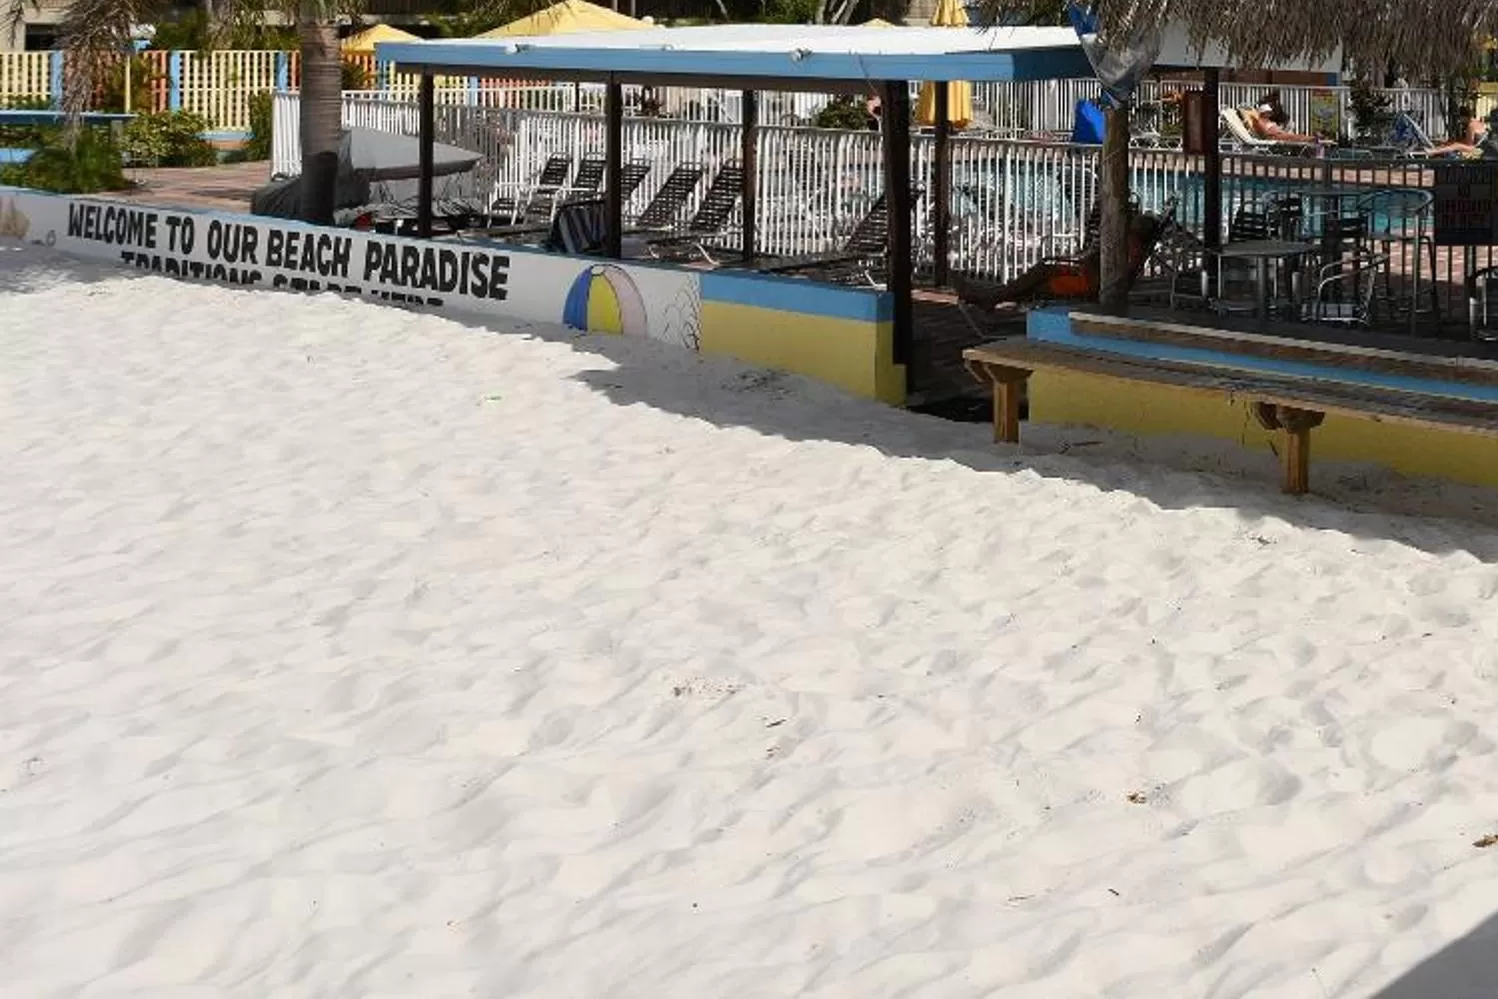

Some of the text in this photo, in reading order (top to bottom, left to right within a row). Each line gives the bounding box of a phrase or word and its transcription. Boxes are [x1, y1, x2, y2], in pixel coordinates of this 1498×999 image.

[67, 203, 158, 248] WELCOME
[165, 215, 194, 254] TO
[207, 219, 258, 264] OUR
[266, 229, 352, 277] BEACH
[364, 240, 510, 300] PARADISE
